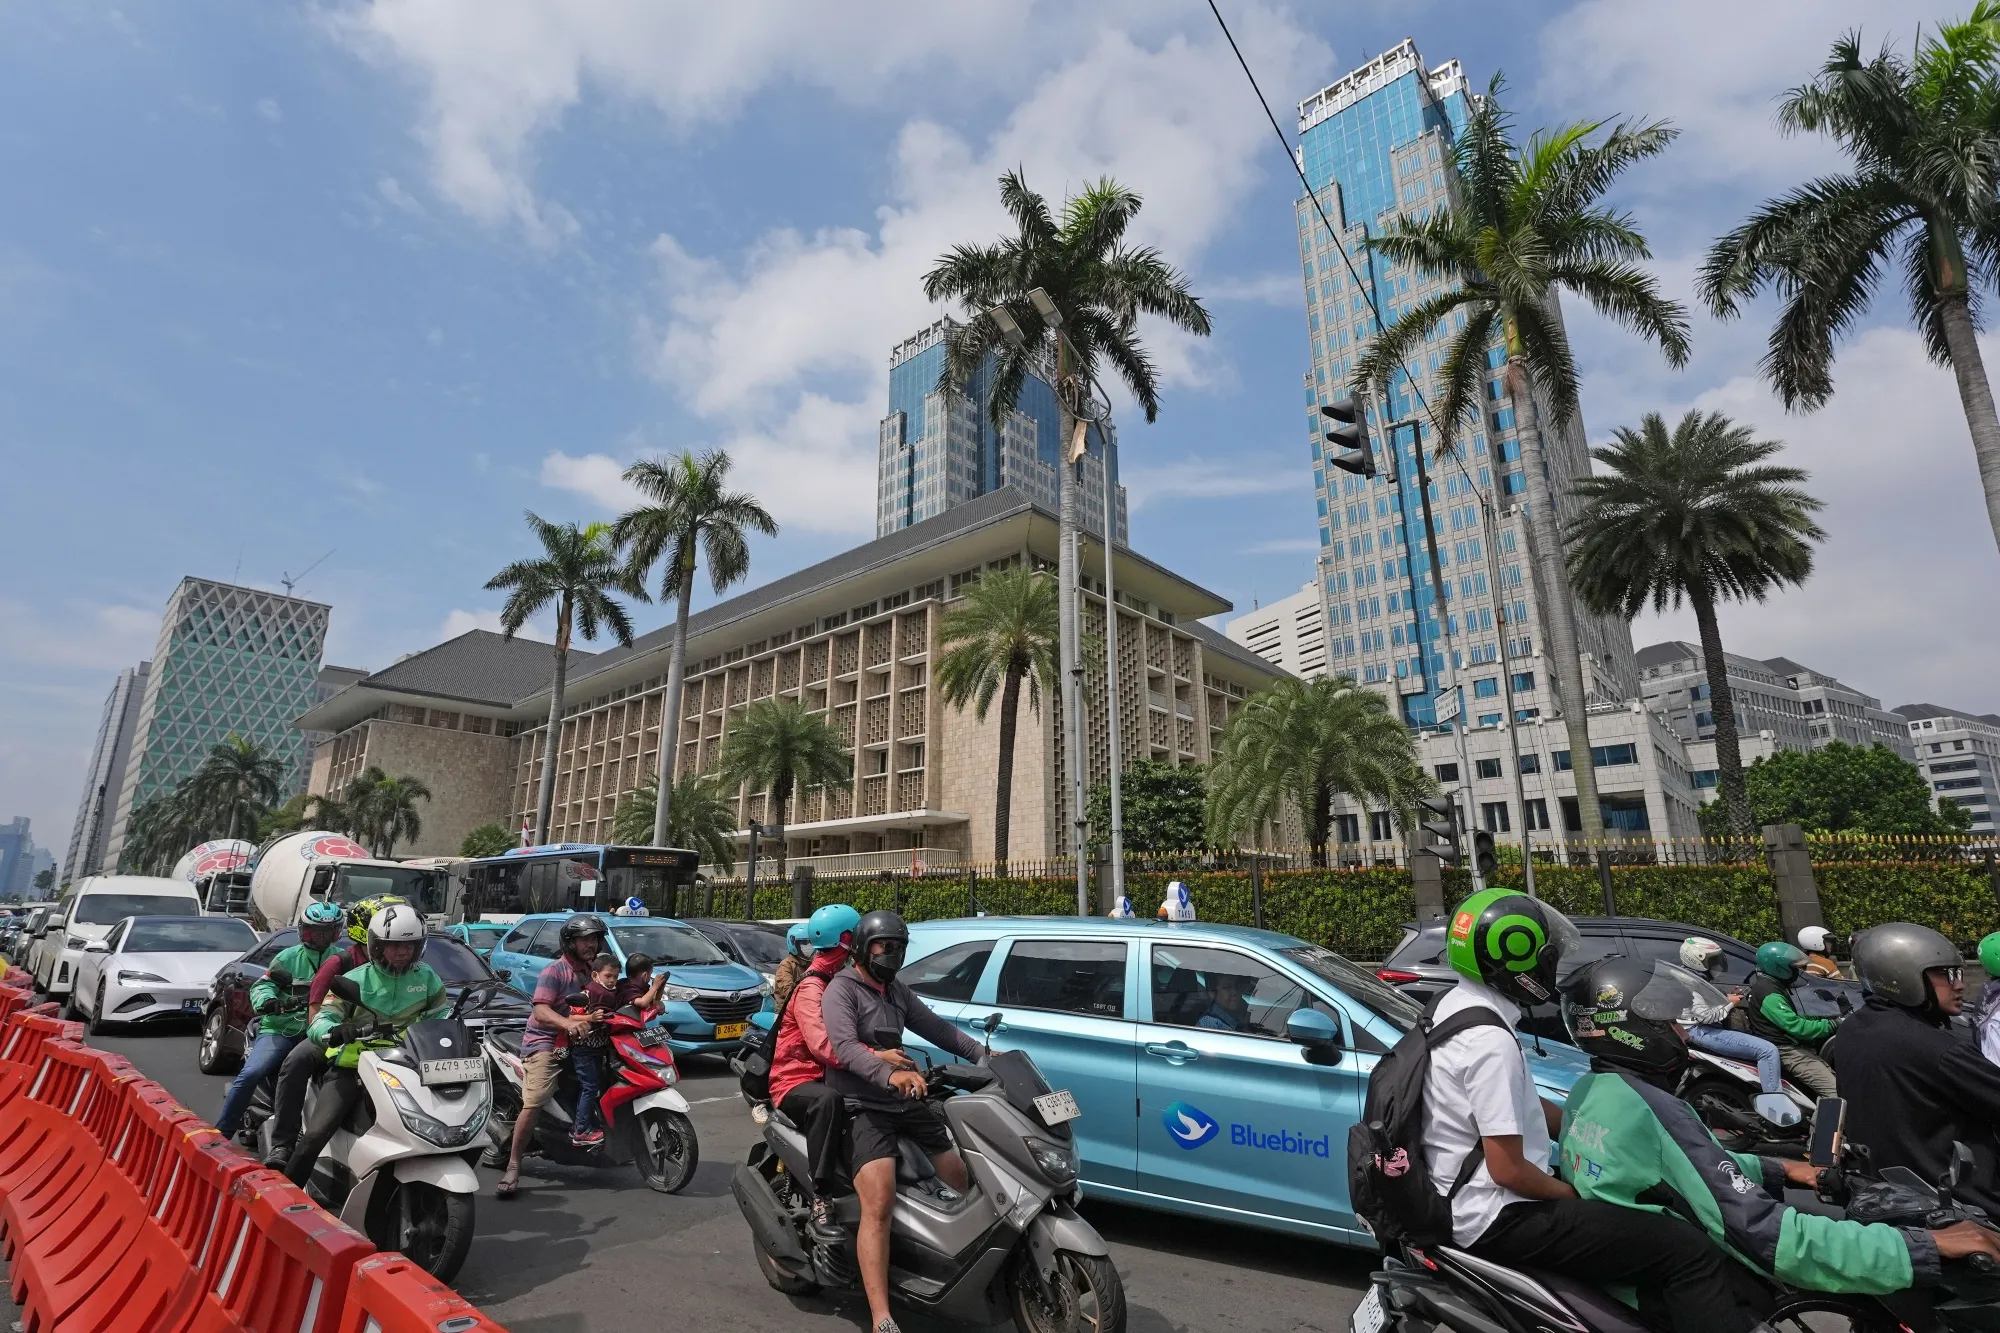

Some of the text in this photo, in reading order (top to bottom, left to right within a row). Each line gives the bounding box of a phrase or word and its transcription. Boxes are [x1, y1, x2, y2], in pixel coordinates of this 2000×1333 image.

[1177, 909, 1193, 919] TAKSI
[717, 1025, 722, 1035] B
[424, 1059, 482, 1073] B 4479 SUS
[1036, 1100, 1045, 1112] B
[1231, 1123, 1329, 1158] Bluebird
